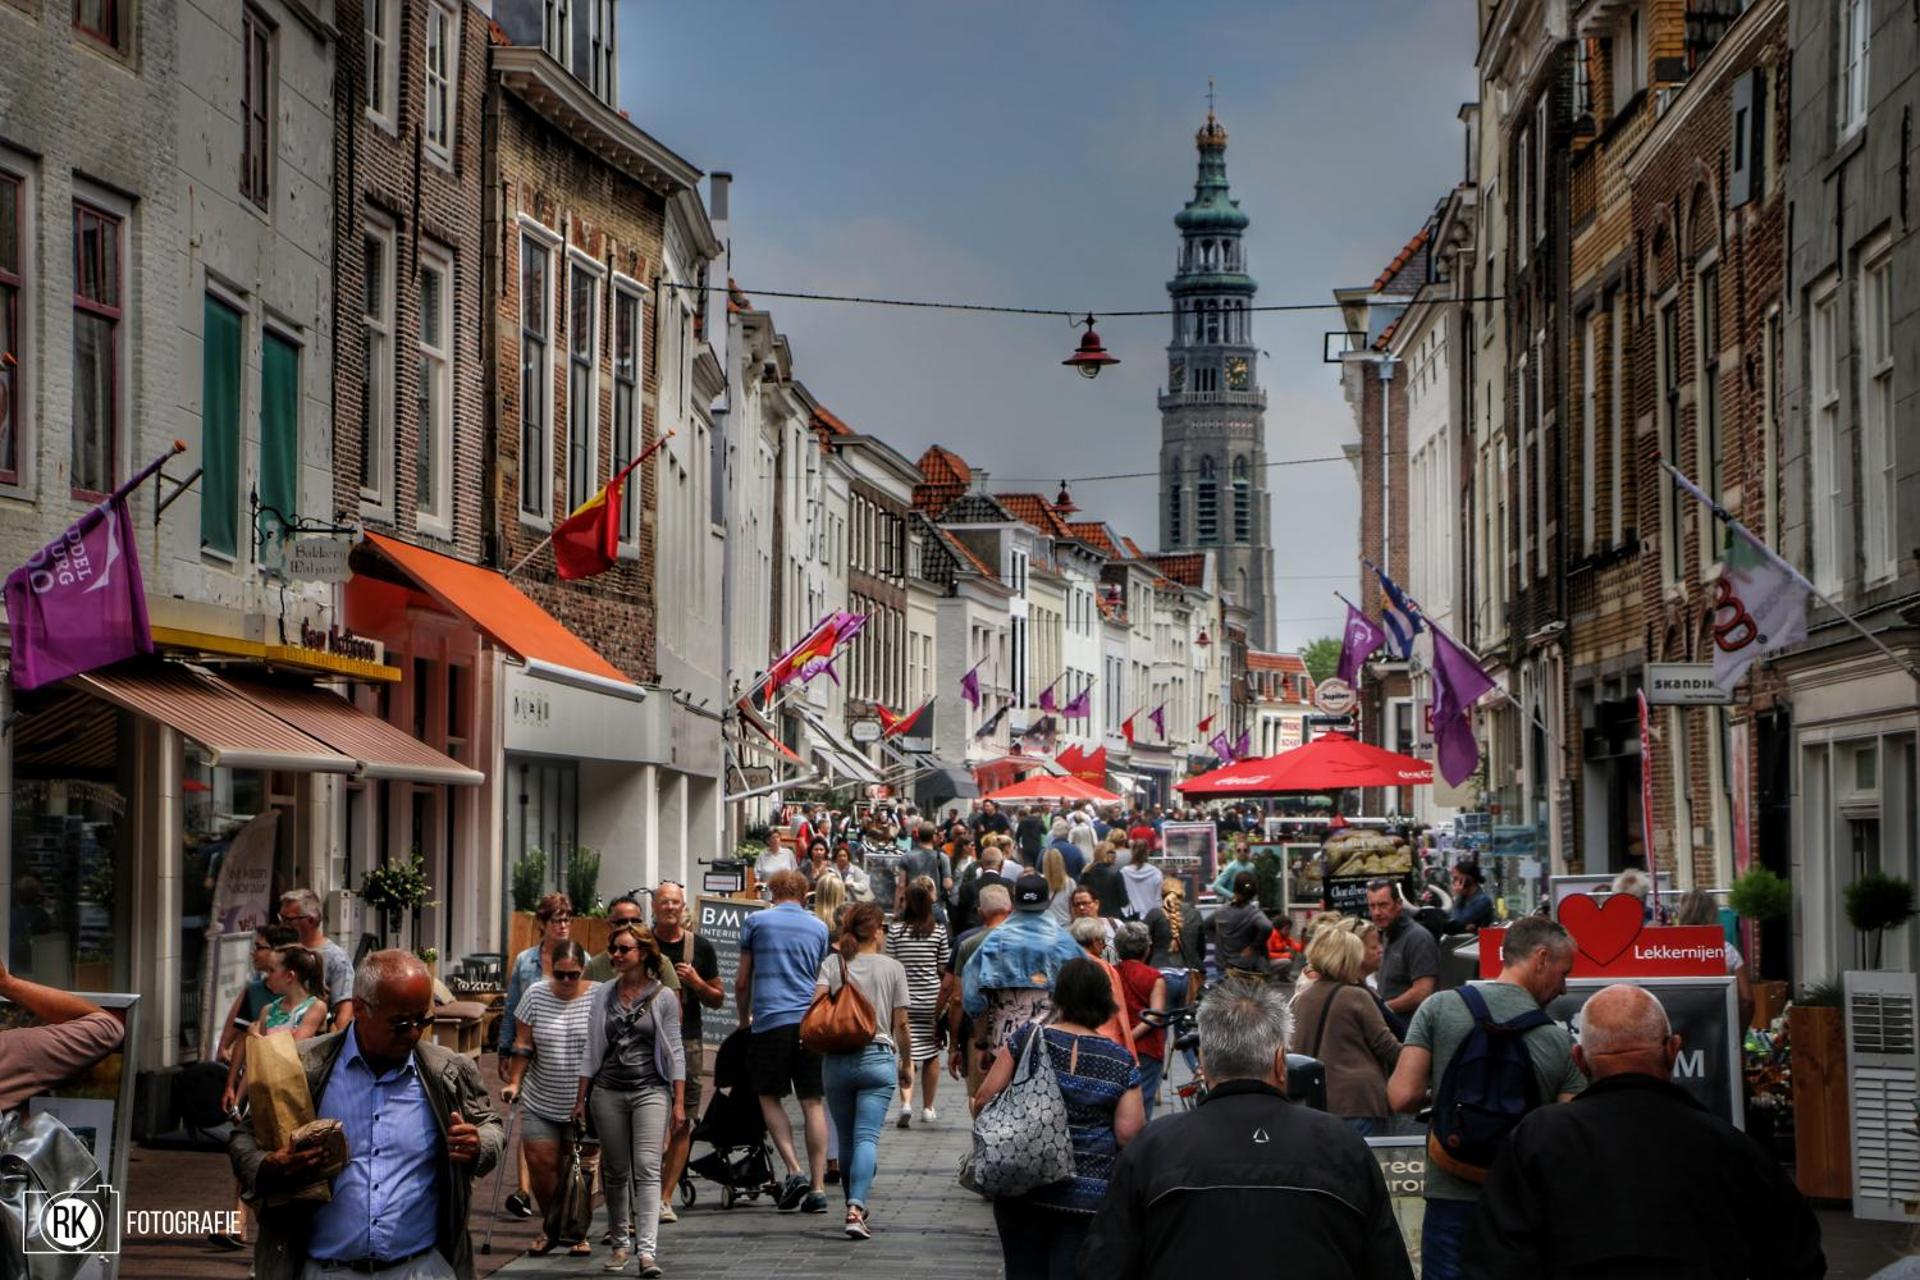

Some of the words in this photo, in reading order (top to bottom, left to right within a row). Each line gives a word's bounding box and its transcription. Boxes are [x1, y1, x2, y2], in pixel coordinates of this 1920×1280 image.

[52, 544, 74, 585] URG
[66, 529, 92, 580] DDEL
[1635, 945, 1724, 962] Lekkernijen
